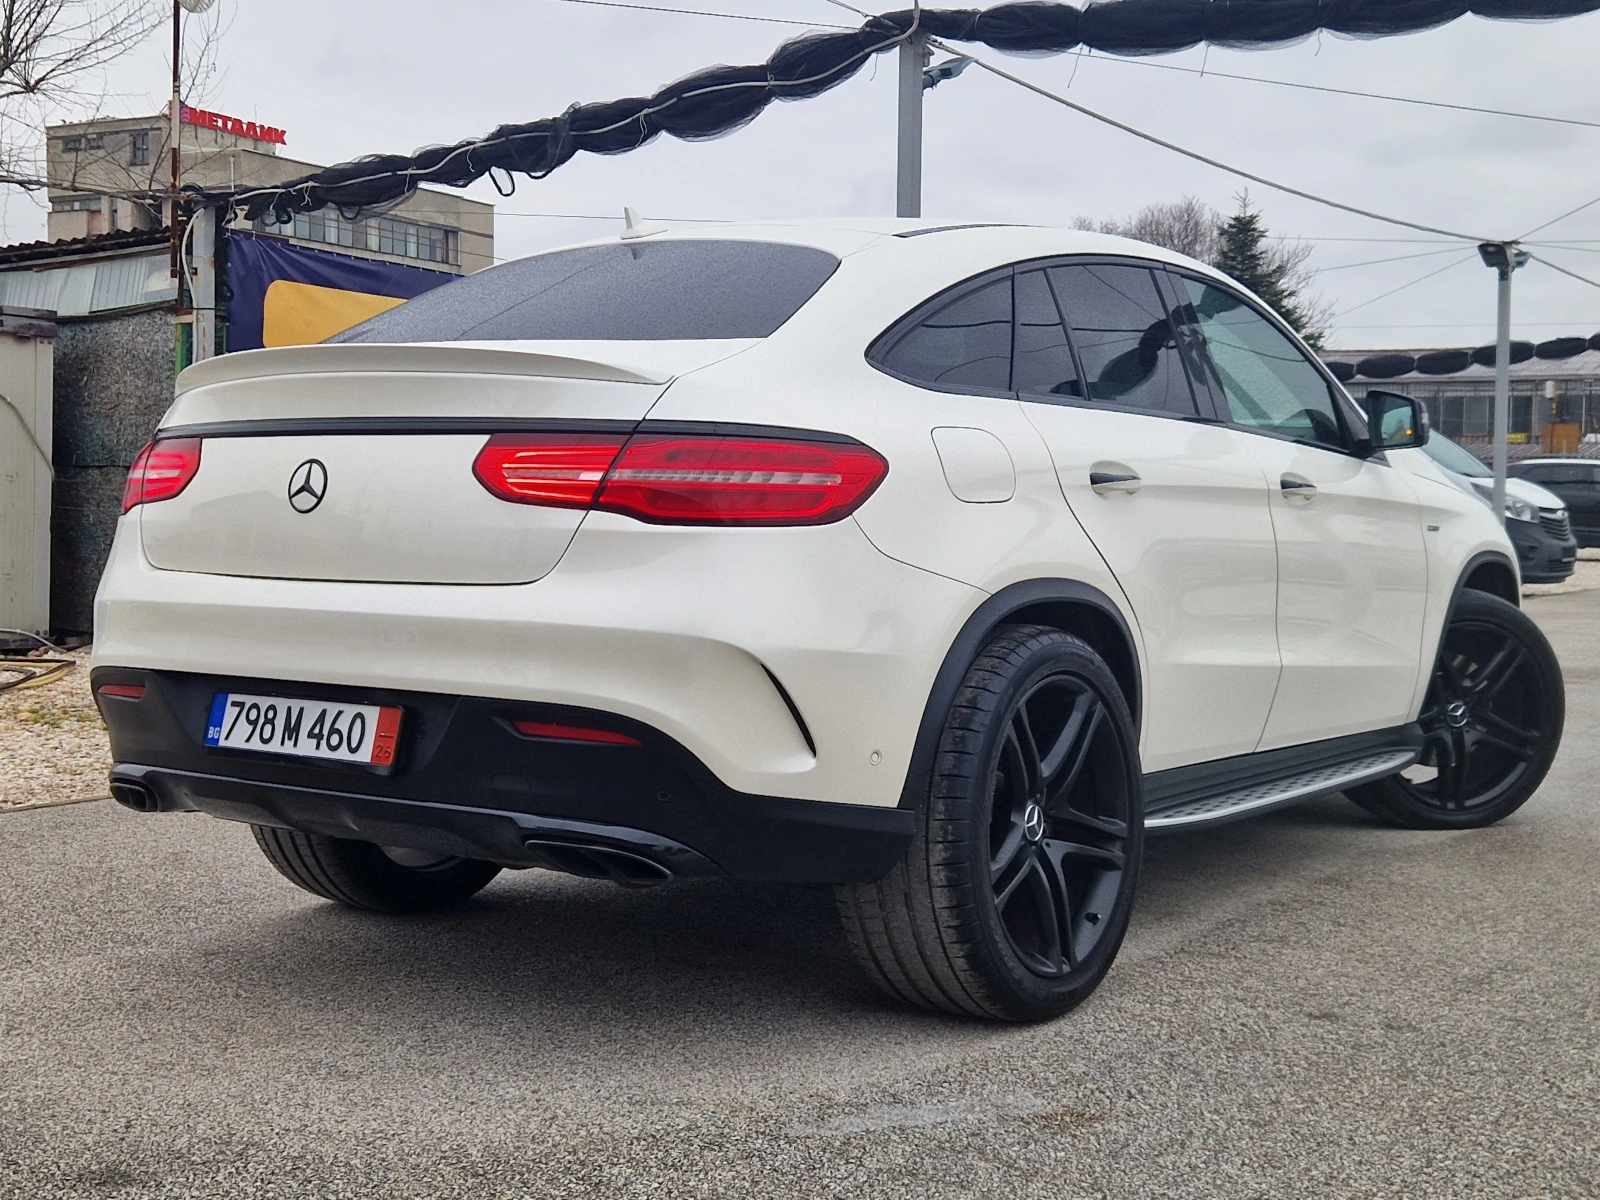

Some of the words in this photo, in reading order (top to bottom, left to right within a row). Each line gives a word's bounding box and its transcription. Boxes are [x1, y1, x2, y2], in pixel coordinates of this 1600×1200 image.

[188, 106, 287, 145] МЕТАЛИК
[207, 726, 220, 739] BG
[224, 701, 278, 745] 798
[280, 705, 304, 748] M
[307, 708, 366, 754] 460
[375, 744, 391, 758] 26
